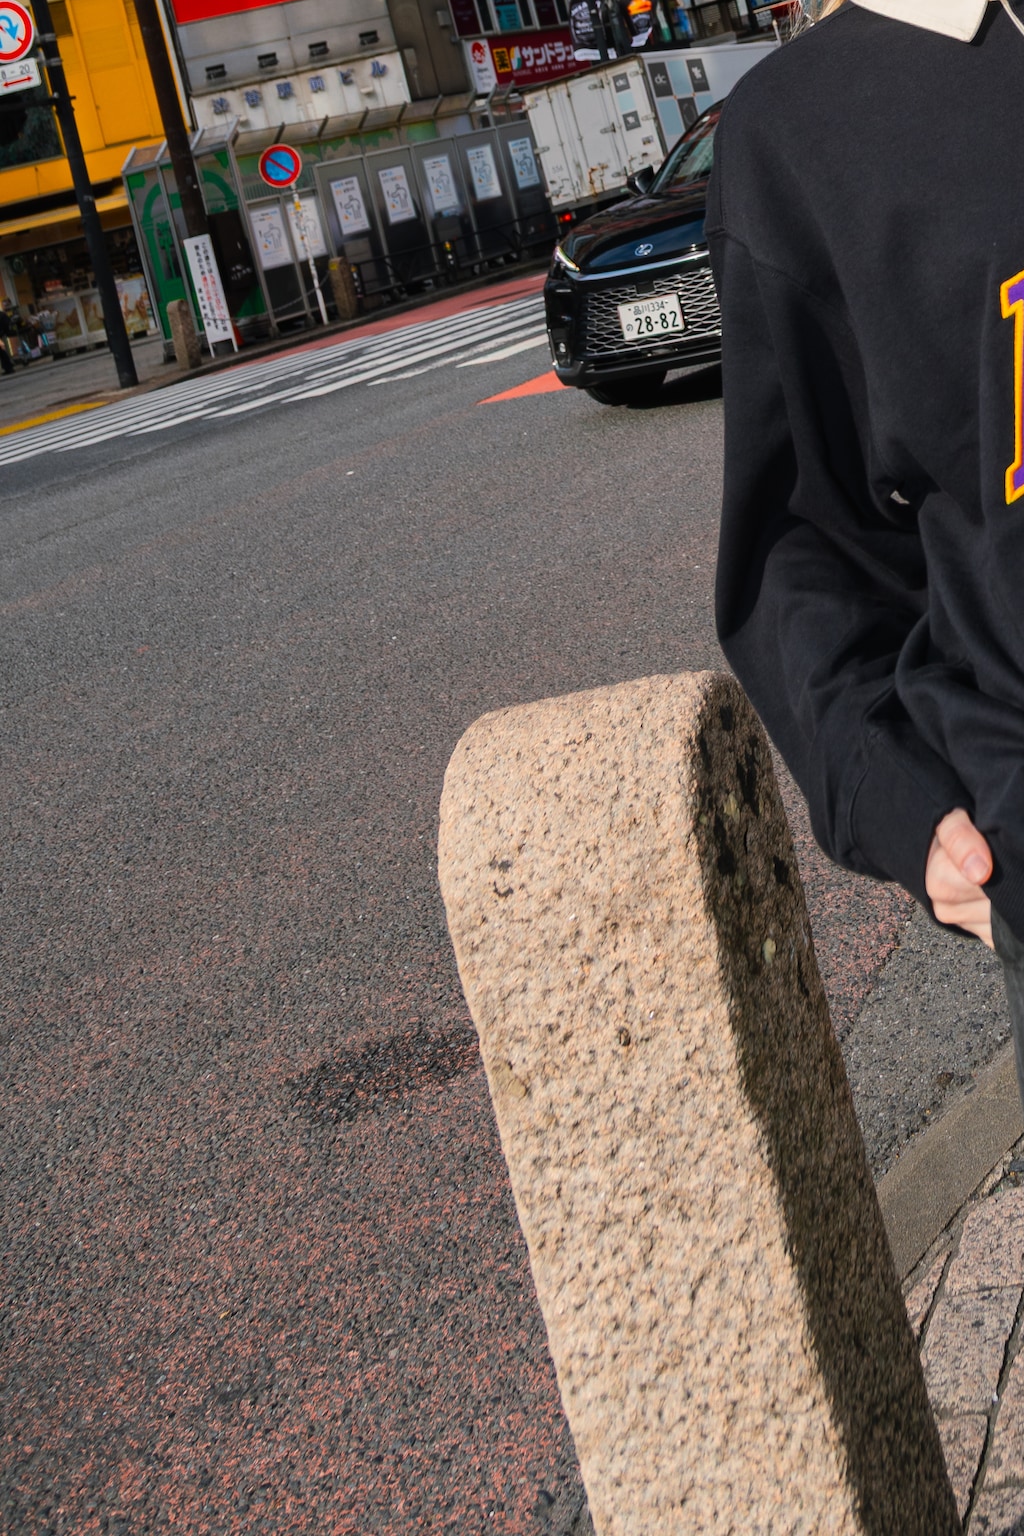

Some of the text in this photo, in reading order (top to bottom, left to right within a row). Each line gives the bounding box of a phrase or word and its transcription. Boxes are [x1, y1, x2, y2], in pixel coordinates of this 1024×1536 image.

[212, 60, 387, 114] 渋谷駅前ビル
[635, 311, 680, 336] 28-82
